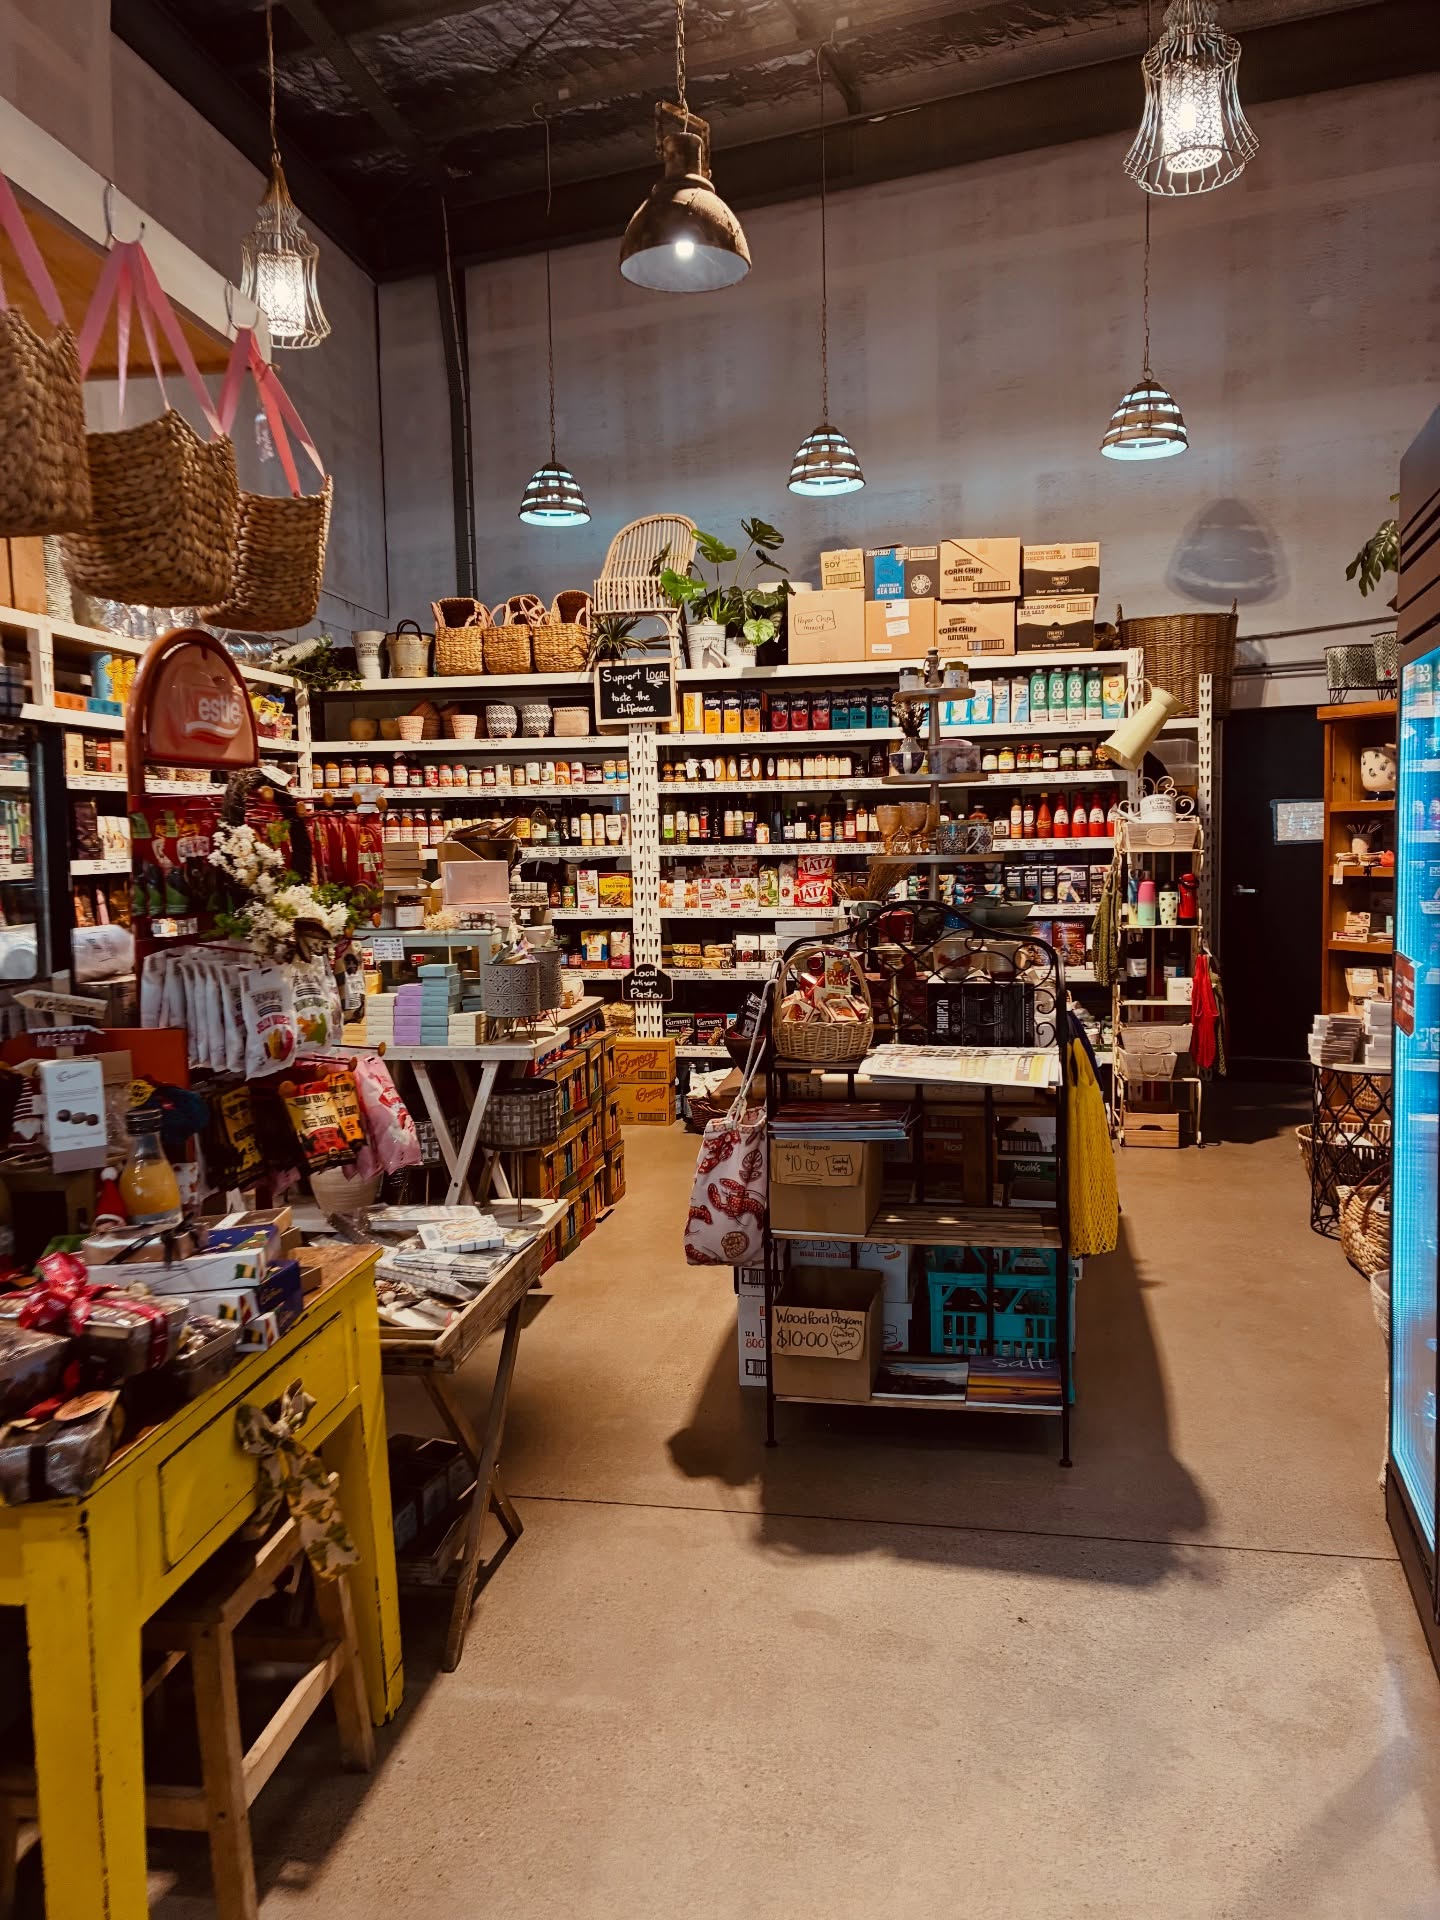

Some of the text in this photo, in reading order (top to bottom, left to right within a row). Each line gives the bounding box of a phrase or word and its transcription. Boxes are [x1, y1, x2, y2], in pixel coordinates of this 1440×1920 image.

[824, 561, 841, 569] SOY
[944, 567, 983, 576] CORN CHIPS
[877, 586, 902, 595] SEA SALT
[938, 627, 958, 635] CORN
[602, 667, 670, 685] Support LOCAL
[611, 691, 651, 702] taste the
[617, 703, 657, 716] difference.
[803, 857, 833, 873] JATZ
[799, 886, 829, 902] JATZ
[634, 967, 658, 978] Local
[630, 979, 658, 987] Artisan
[630, 988, 664, 999] Pasta
[616, 1051, 660, 1075] Bonsoy
[636, 1086, 667, 1103] Bonsoy
[776, 1308, 830, 1325] Woodford
[745, 1338, 765, 1349] 800
[991, 1357, 1053, 1370] salt
